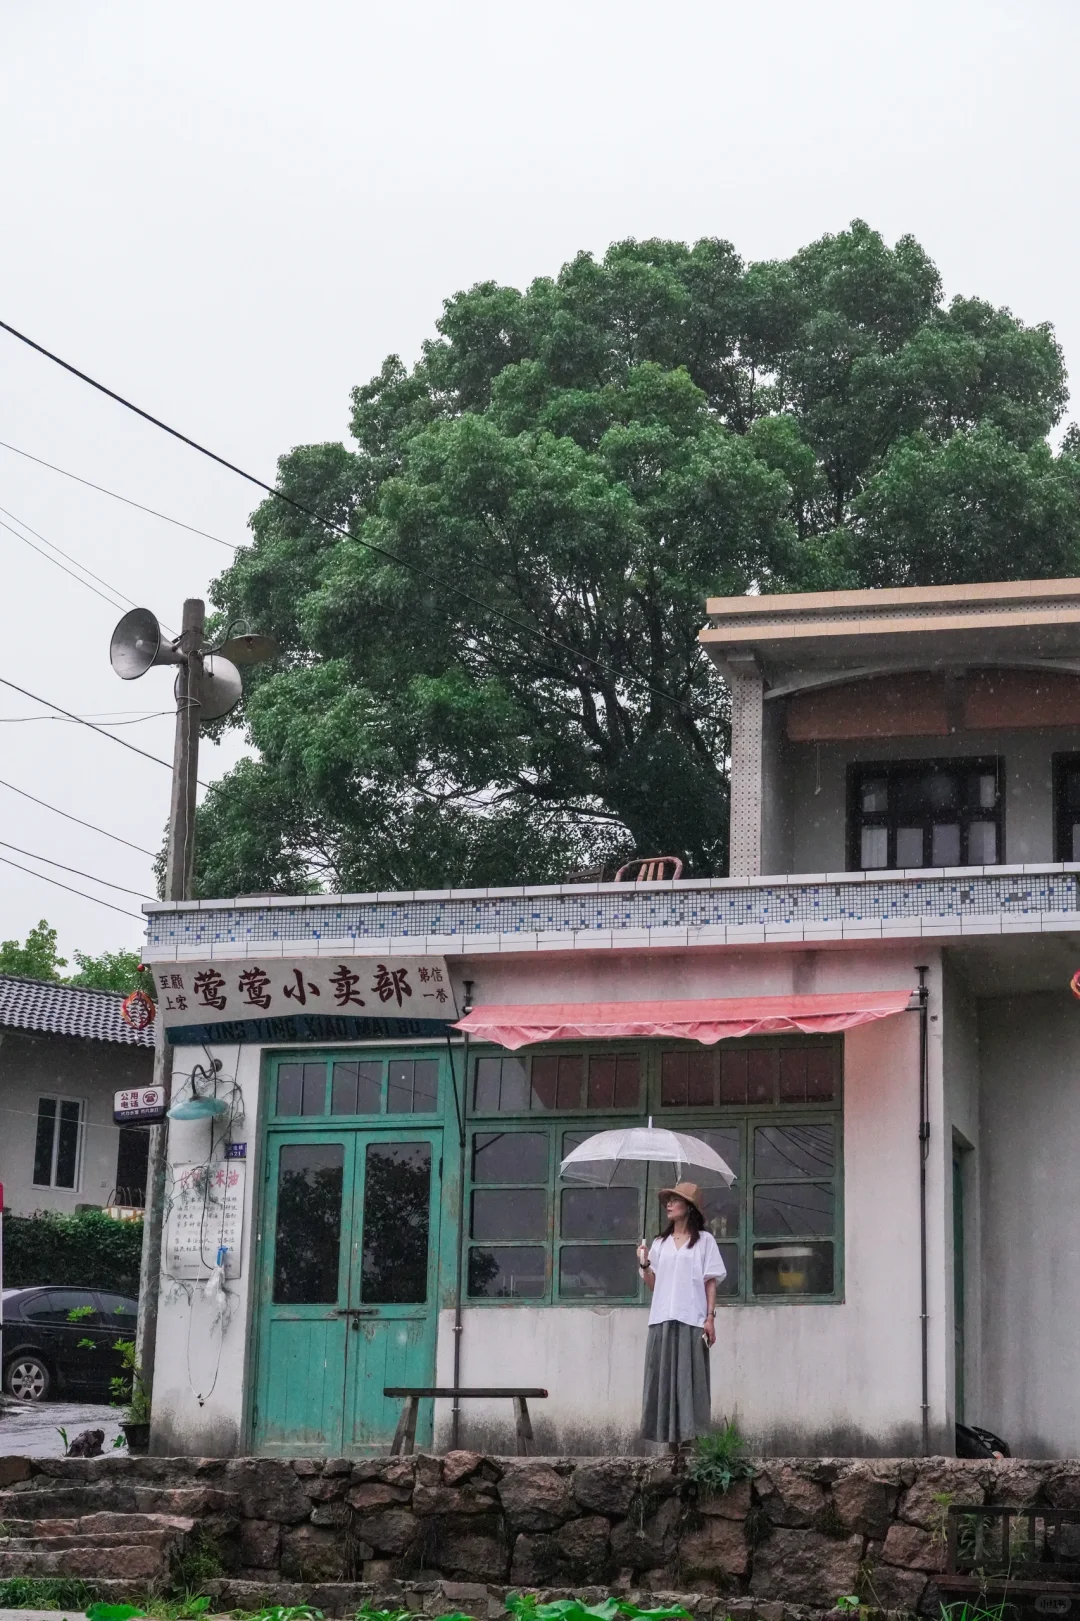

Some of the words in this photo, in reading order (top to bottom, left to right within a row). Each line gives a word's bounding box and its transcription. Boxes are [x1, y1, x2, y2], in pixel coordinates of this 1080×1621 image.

[193, 964, 413, 1011] 莺莺小卖部
[253, 1017, 298, 1039] YING
[303, 1016, 348, 1037] XIAO
[355, 1017, 389, 1037] MAI
[120, 1092, 139, 1101] 公用
[120, 1101, 139, 1109] 电话
